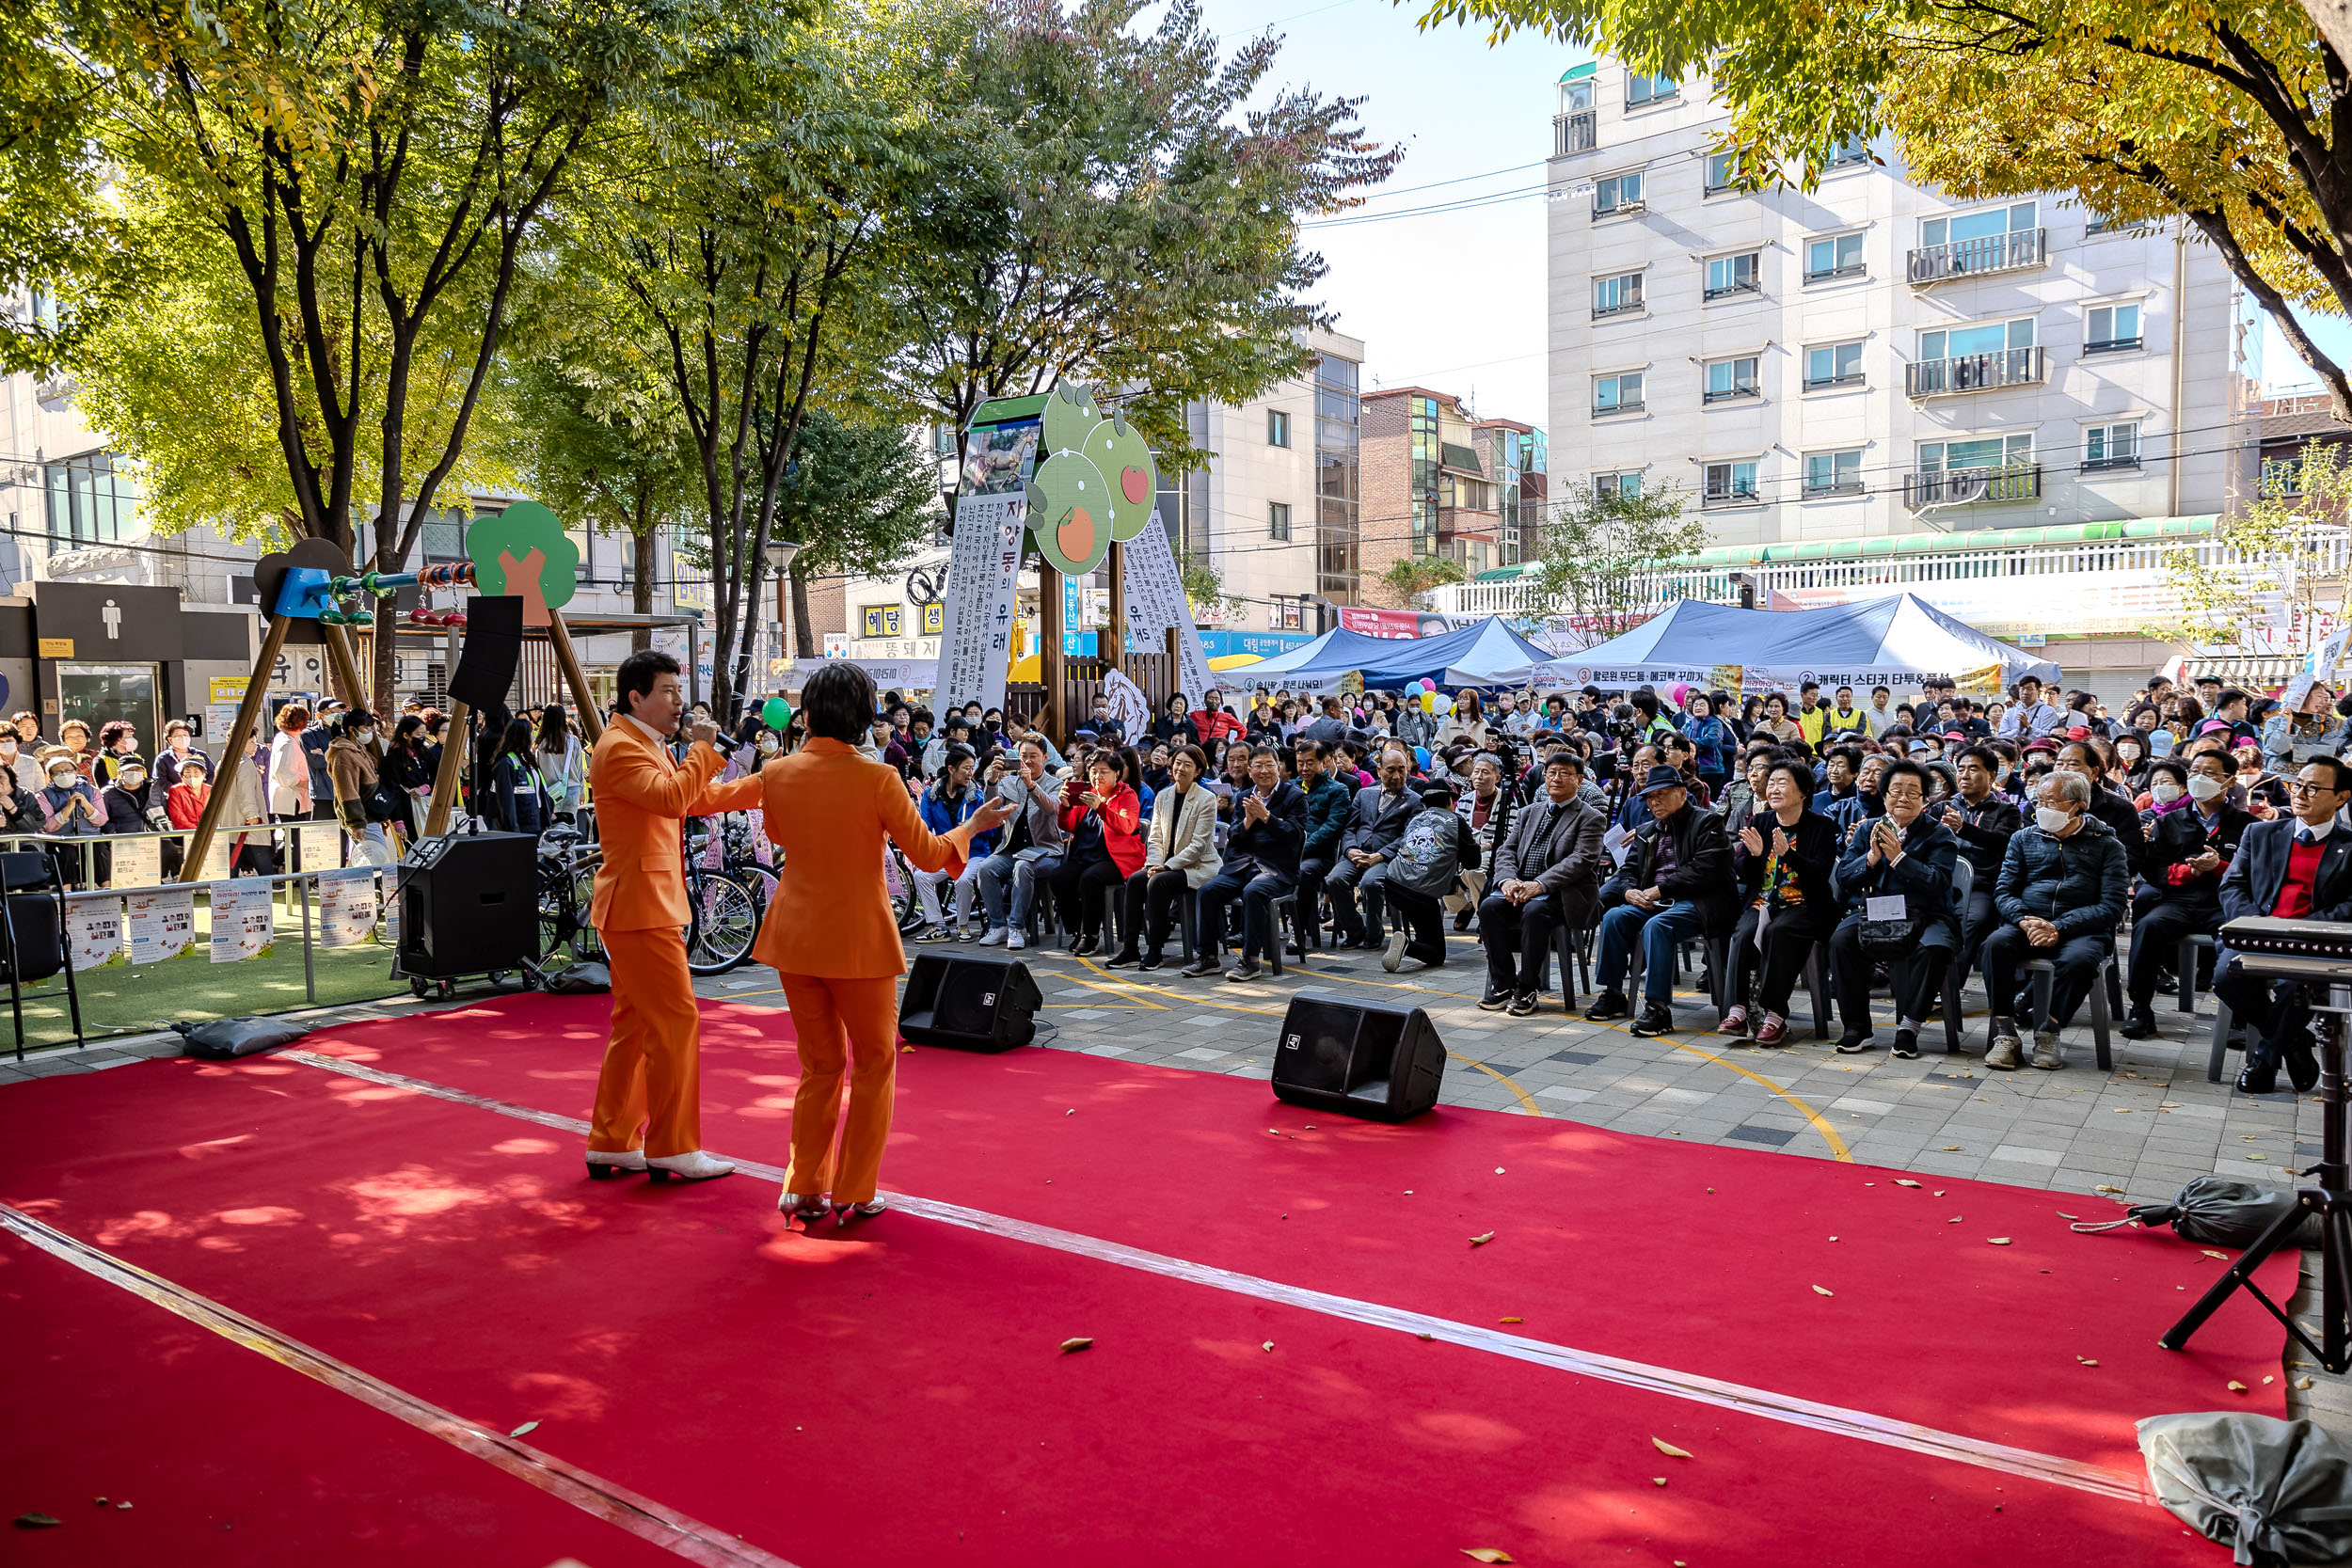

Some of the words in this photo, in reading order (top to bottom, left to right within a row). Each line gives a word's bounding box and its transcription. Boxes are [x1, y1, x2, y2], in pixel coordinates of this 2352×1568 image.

[1000, 499, 1024, 590] 자양동의
[986, 563, 997, 600] 조선시대
[1066, 586, 1076, 624] 부동산
[928, 608, 940, 626] 생
[993, 604, 1009, 651] 유래
[1243, 637, 1259, 653] 대림
[1283, 680, 1296, 689] 팝콘
[1298, 679, 1323, 689] 나눠요!
[1677, 671, 1704, 682] 꾸미기
[1818, 673, 1851, 686] 캐릭터
[1854, 673, 1888, 685] 스티커
